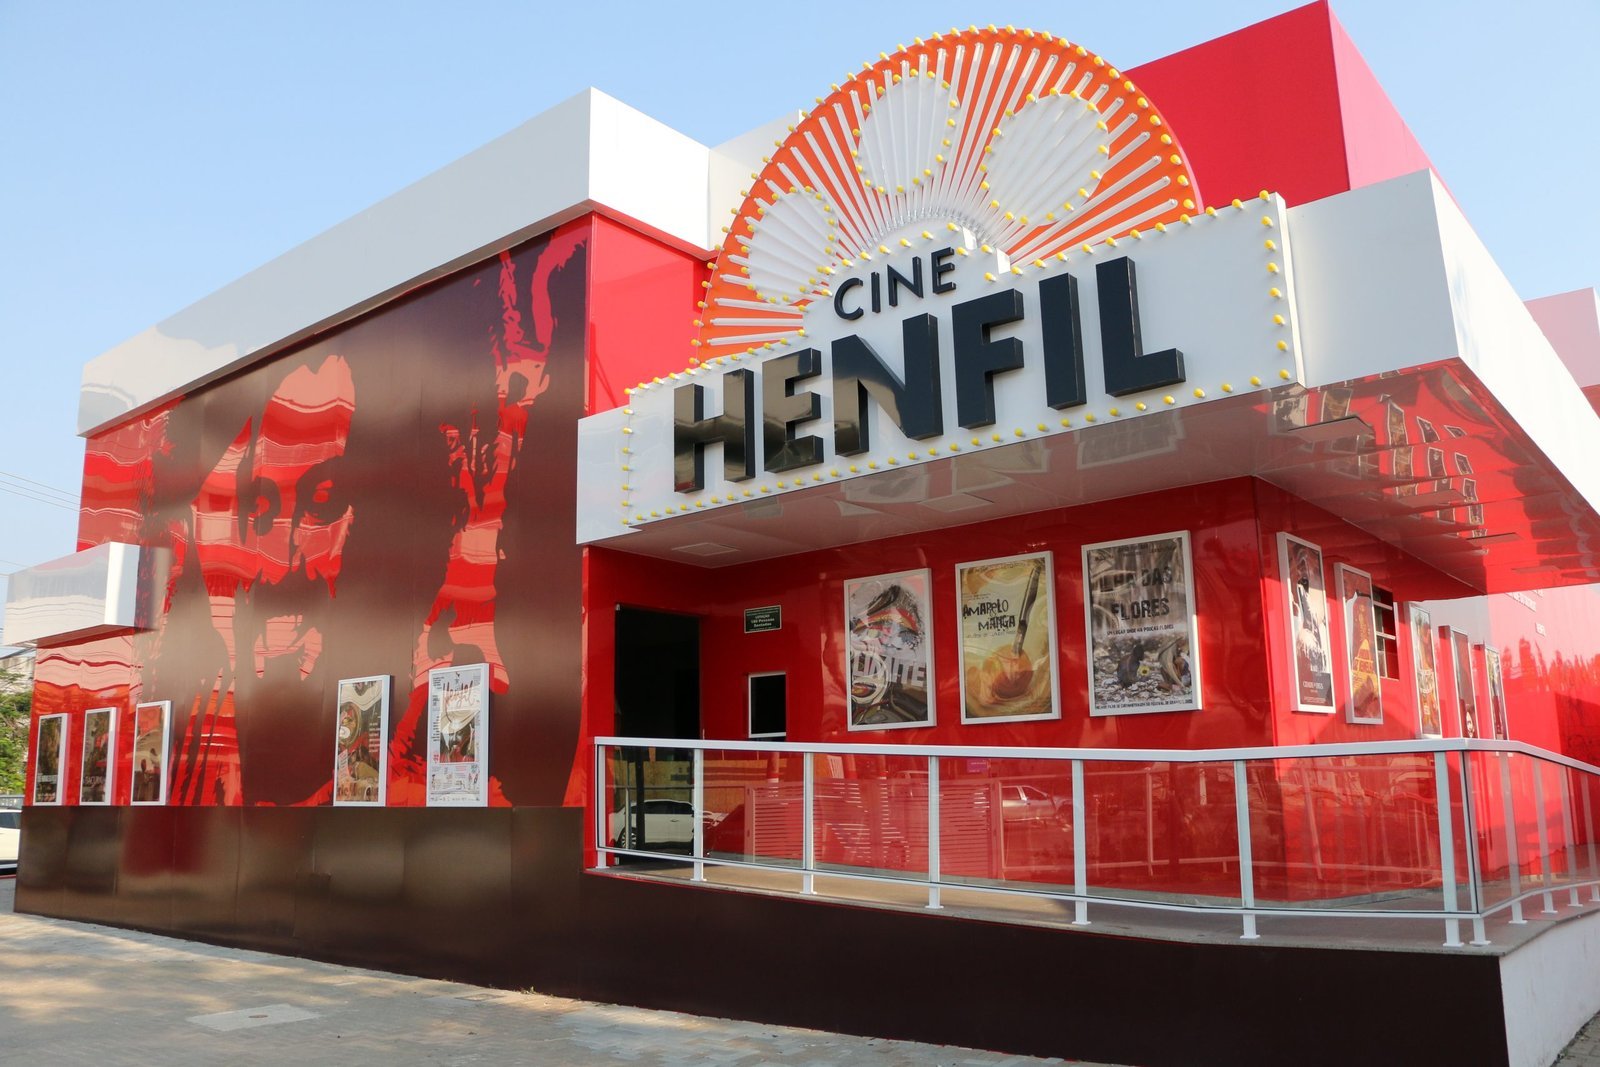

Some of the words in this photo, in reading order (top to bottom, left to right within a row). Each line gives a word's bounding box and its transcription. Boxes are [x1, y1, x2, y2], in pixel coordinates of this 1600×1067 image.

[834, 246, 958, 321] CINE
[673, 256, 1187, 493] HENFIL
[1141, 566, 1173, 586] DAS
[963, 599, 1009, 619] AMARELO
[1111, 597, 1170, 621] FLORES
[978, 615, 1016, 631] MANGA
[852, 653, 926, 687] LIMITE
